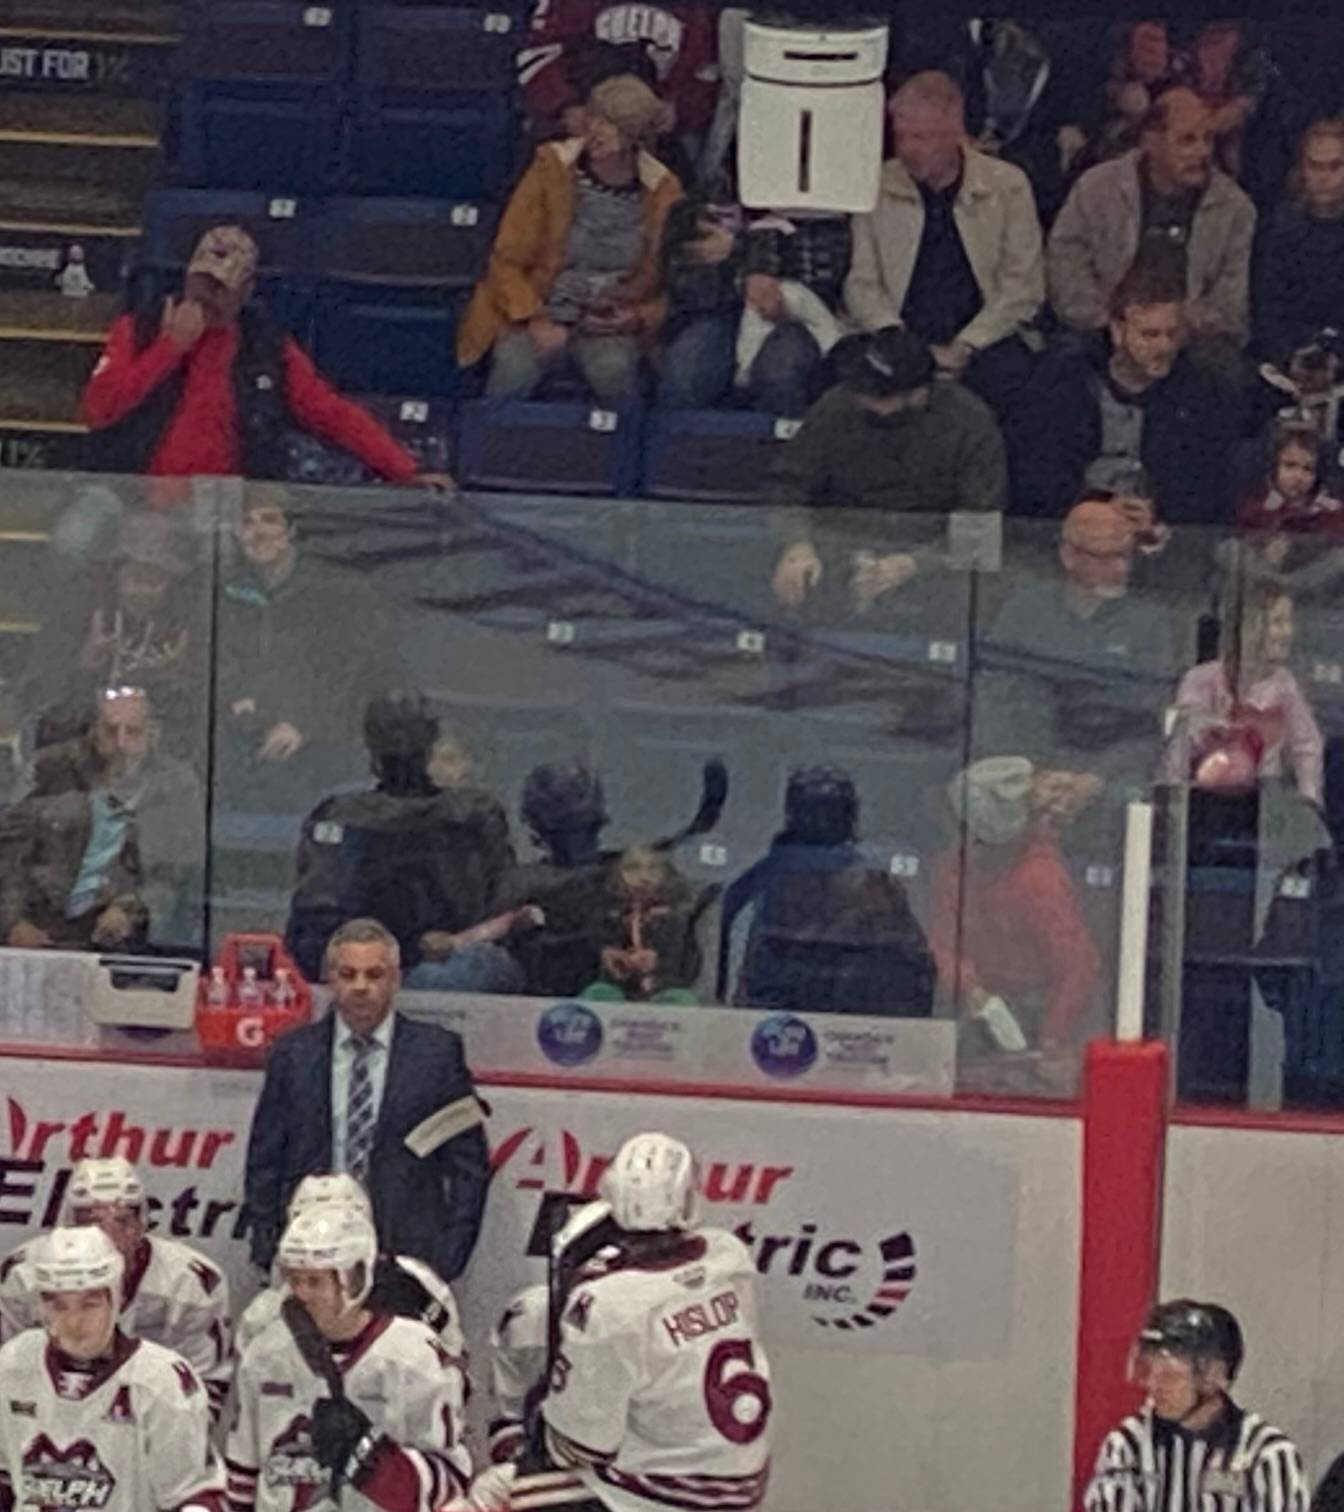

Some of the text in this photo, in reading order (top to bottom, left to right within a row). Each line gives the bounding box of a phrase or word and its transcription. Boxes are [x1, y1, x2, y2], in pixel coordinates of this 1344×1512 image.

[42, 50, 89, 79] FOR
[236, 1017, 265, 1047] G
[804, 1284, 853, 1303] INC.
[662, 1290, 741, 1348] HISLOP
[110, 1384, 137, 1424] A
[703, 1338, 773, 1446] 6
